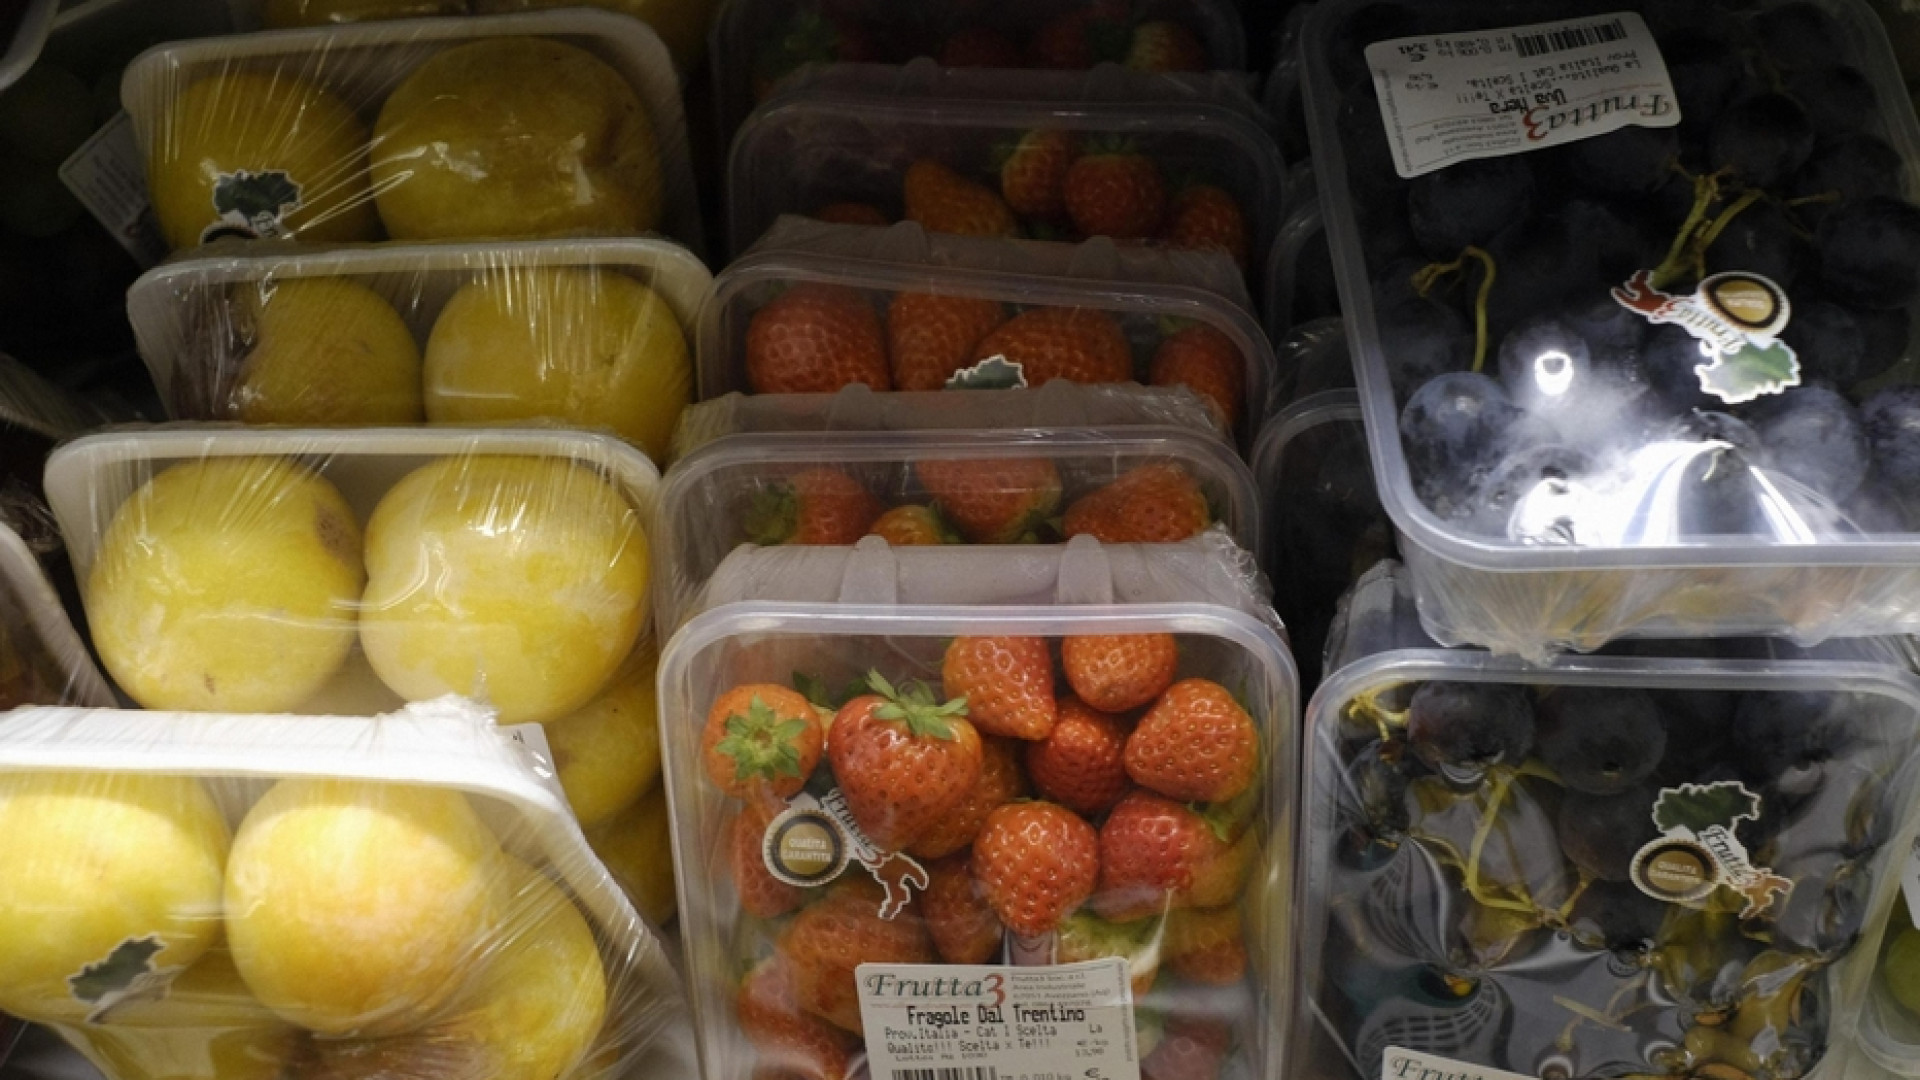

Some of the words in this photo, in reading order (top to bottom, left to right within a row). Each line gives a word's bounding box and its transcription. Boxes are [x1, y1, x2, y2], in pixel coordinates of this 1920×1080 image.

[1535, 89, 1567, 106] Uva
[906, 1004, 970, 1029] Fragole
[978, 1003, 1004, 1024] Dal
[1013, 1002, 1085, 1023] Trentino
[976, 1025, 998, 1038] Cat
[1015, 1023, 1058, 1038] Scelta
[958, 1040, 1001, 1053] Scelta
